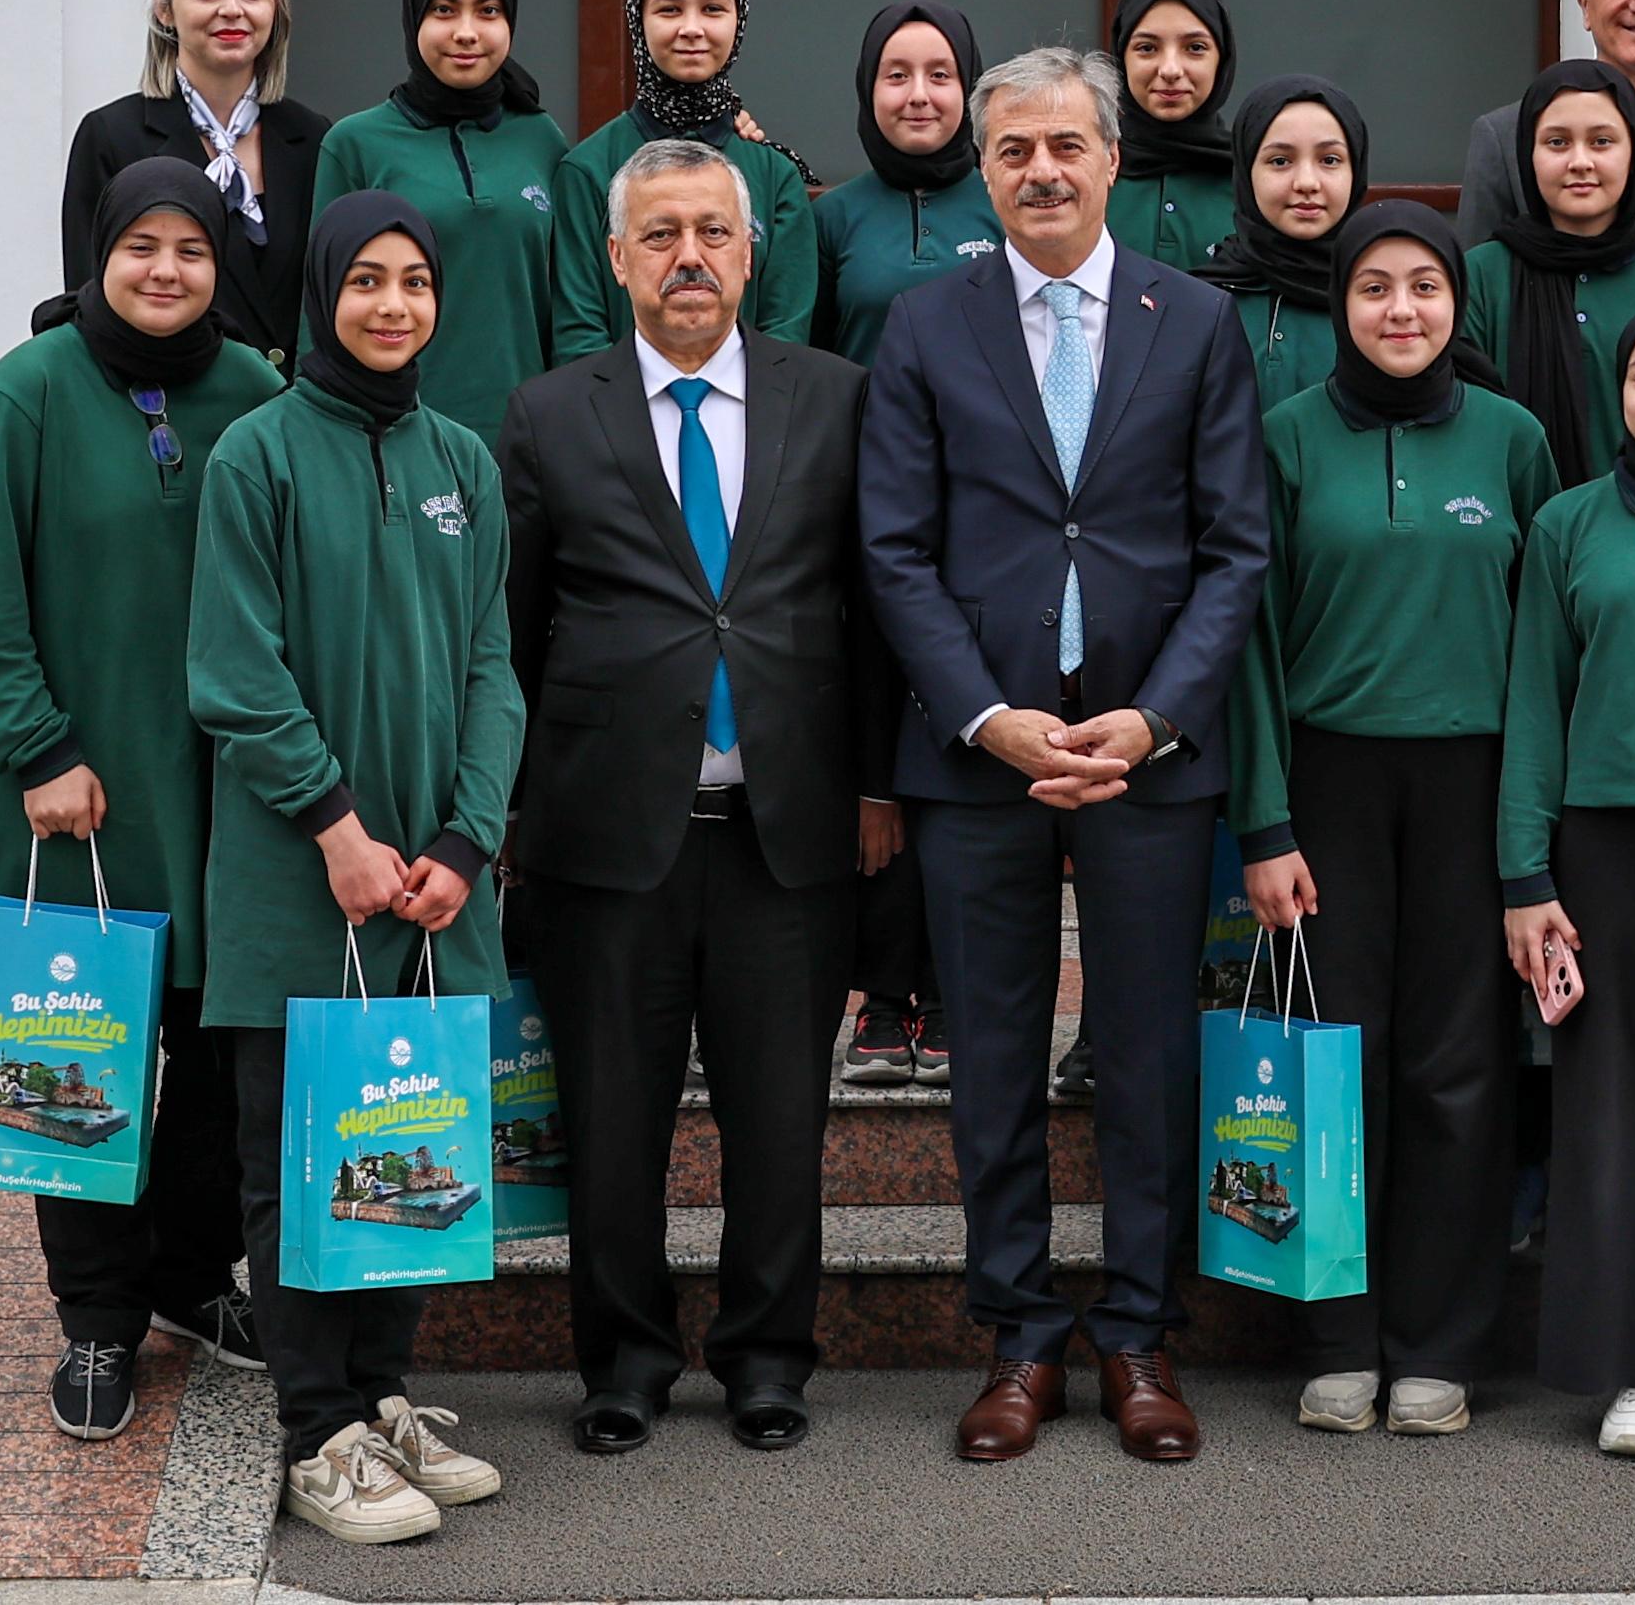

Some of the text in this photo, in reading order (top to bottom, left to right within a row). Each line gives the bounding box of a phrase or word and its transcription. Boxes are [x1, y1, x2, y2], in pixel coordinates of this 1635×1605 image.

[11, 991, 103, 1015] Bu Şehir
[491, 1058, 517, 1077] Bu
[361, 1073, 440, 1105] Bu Şehir
[336, 1090, 469, 1141] Hepimizin
[1235, 1094, 1287, 1118] Bu Şehir
[1213, 1110, 1297, 1144] Hepimizin
[363, 1267, 447, 1282] #BuŞehirHepimizin
